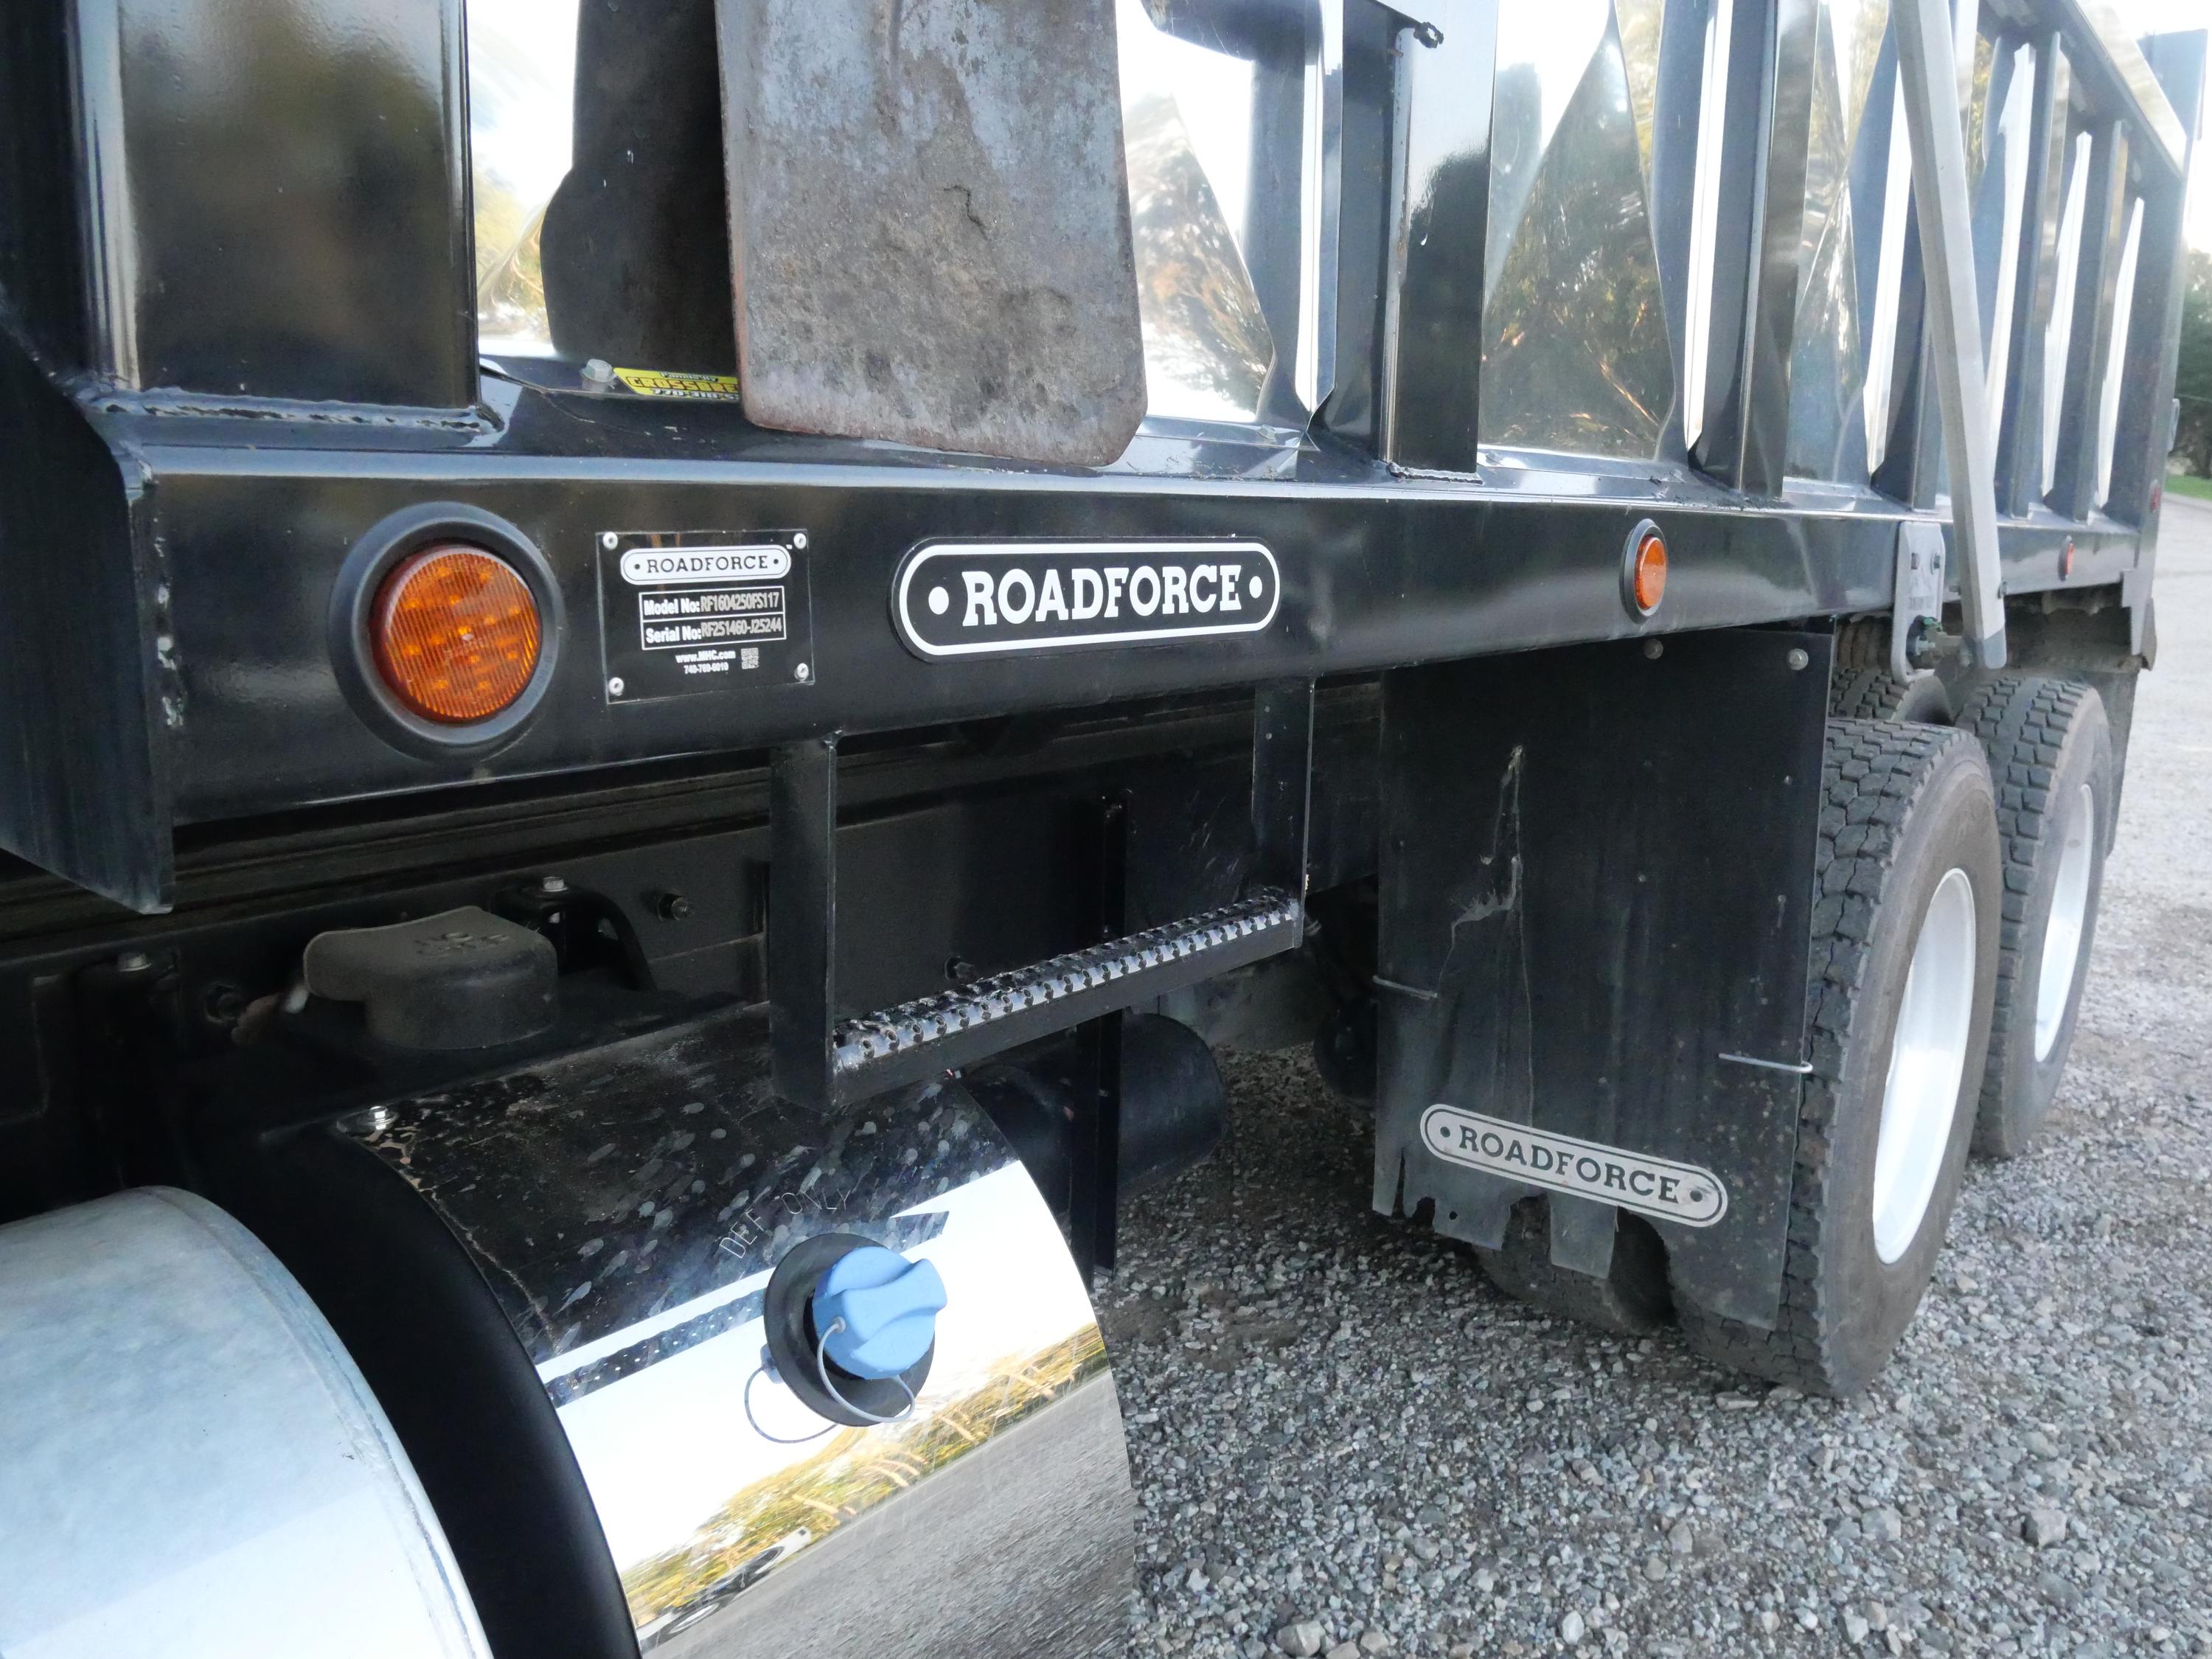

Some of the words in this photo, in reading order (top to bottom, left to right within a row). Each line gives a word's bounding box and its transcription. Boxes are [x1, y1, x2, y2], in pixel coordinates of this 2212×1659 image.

[626, 376, 737, 393] CROSSBRE
[647, 555, 768, 573] ROADFORCE
[961, 564, 1242, 627] ROADFORCE
[644, 599, 679, 616] Model
[681, 597, 700, 614] No:
[645, 626, 681, 644] Serial
[682, 625, 702, 641] No:
[1458, 1124, 1680, 1203] ROADFORCE
[720, 1208, 765, 1259] DEF
[781, 1187, 851, 1214] ONLY
